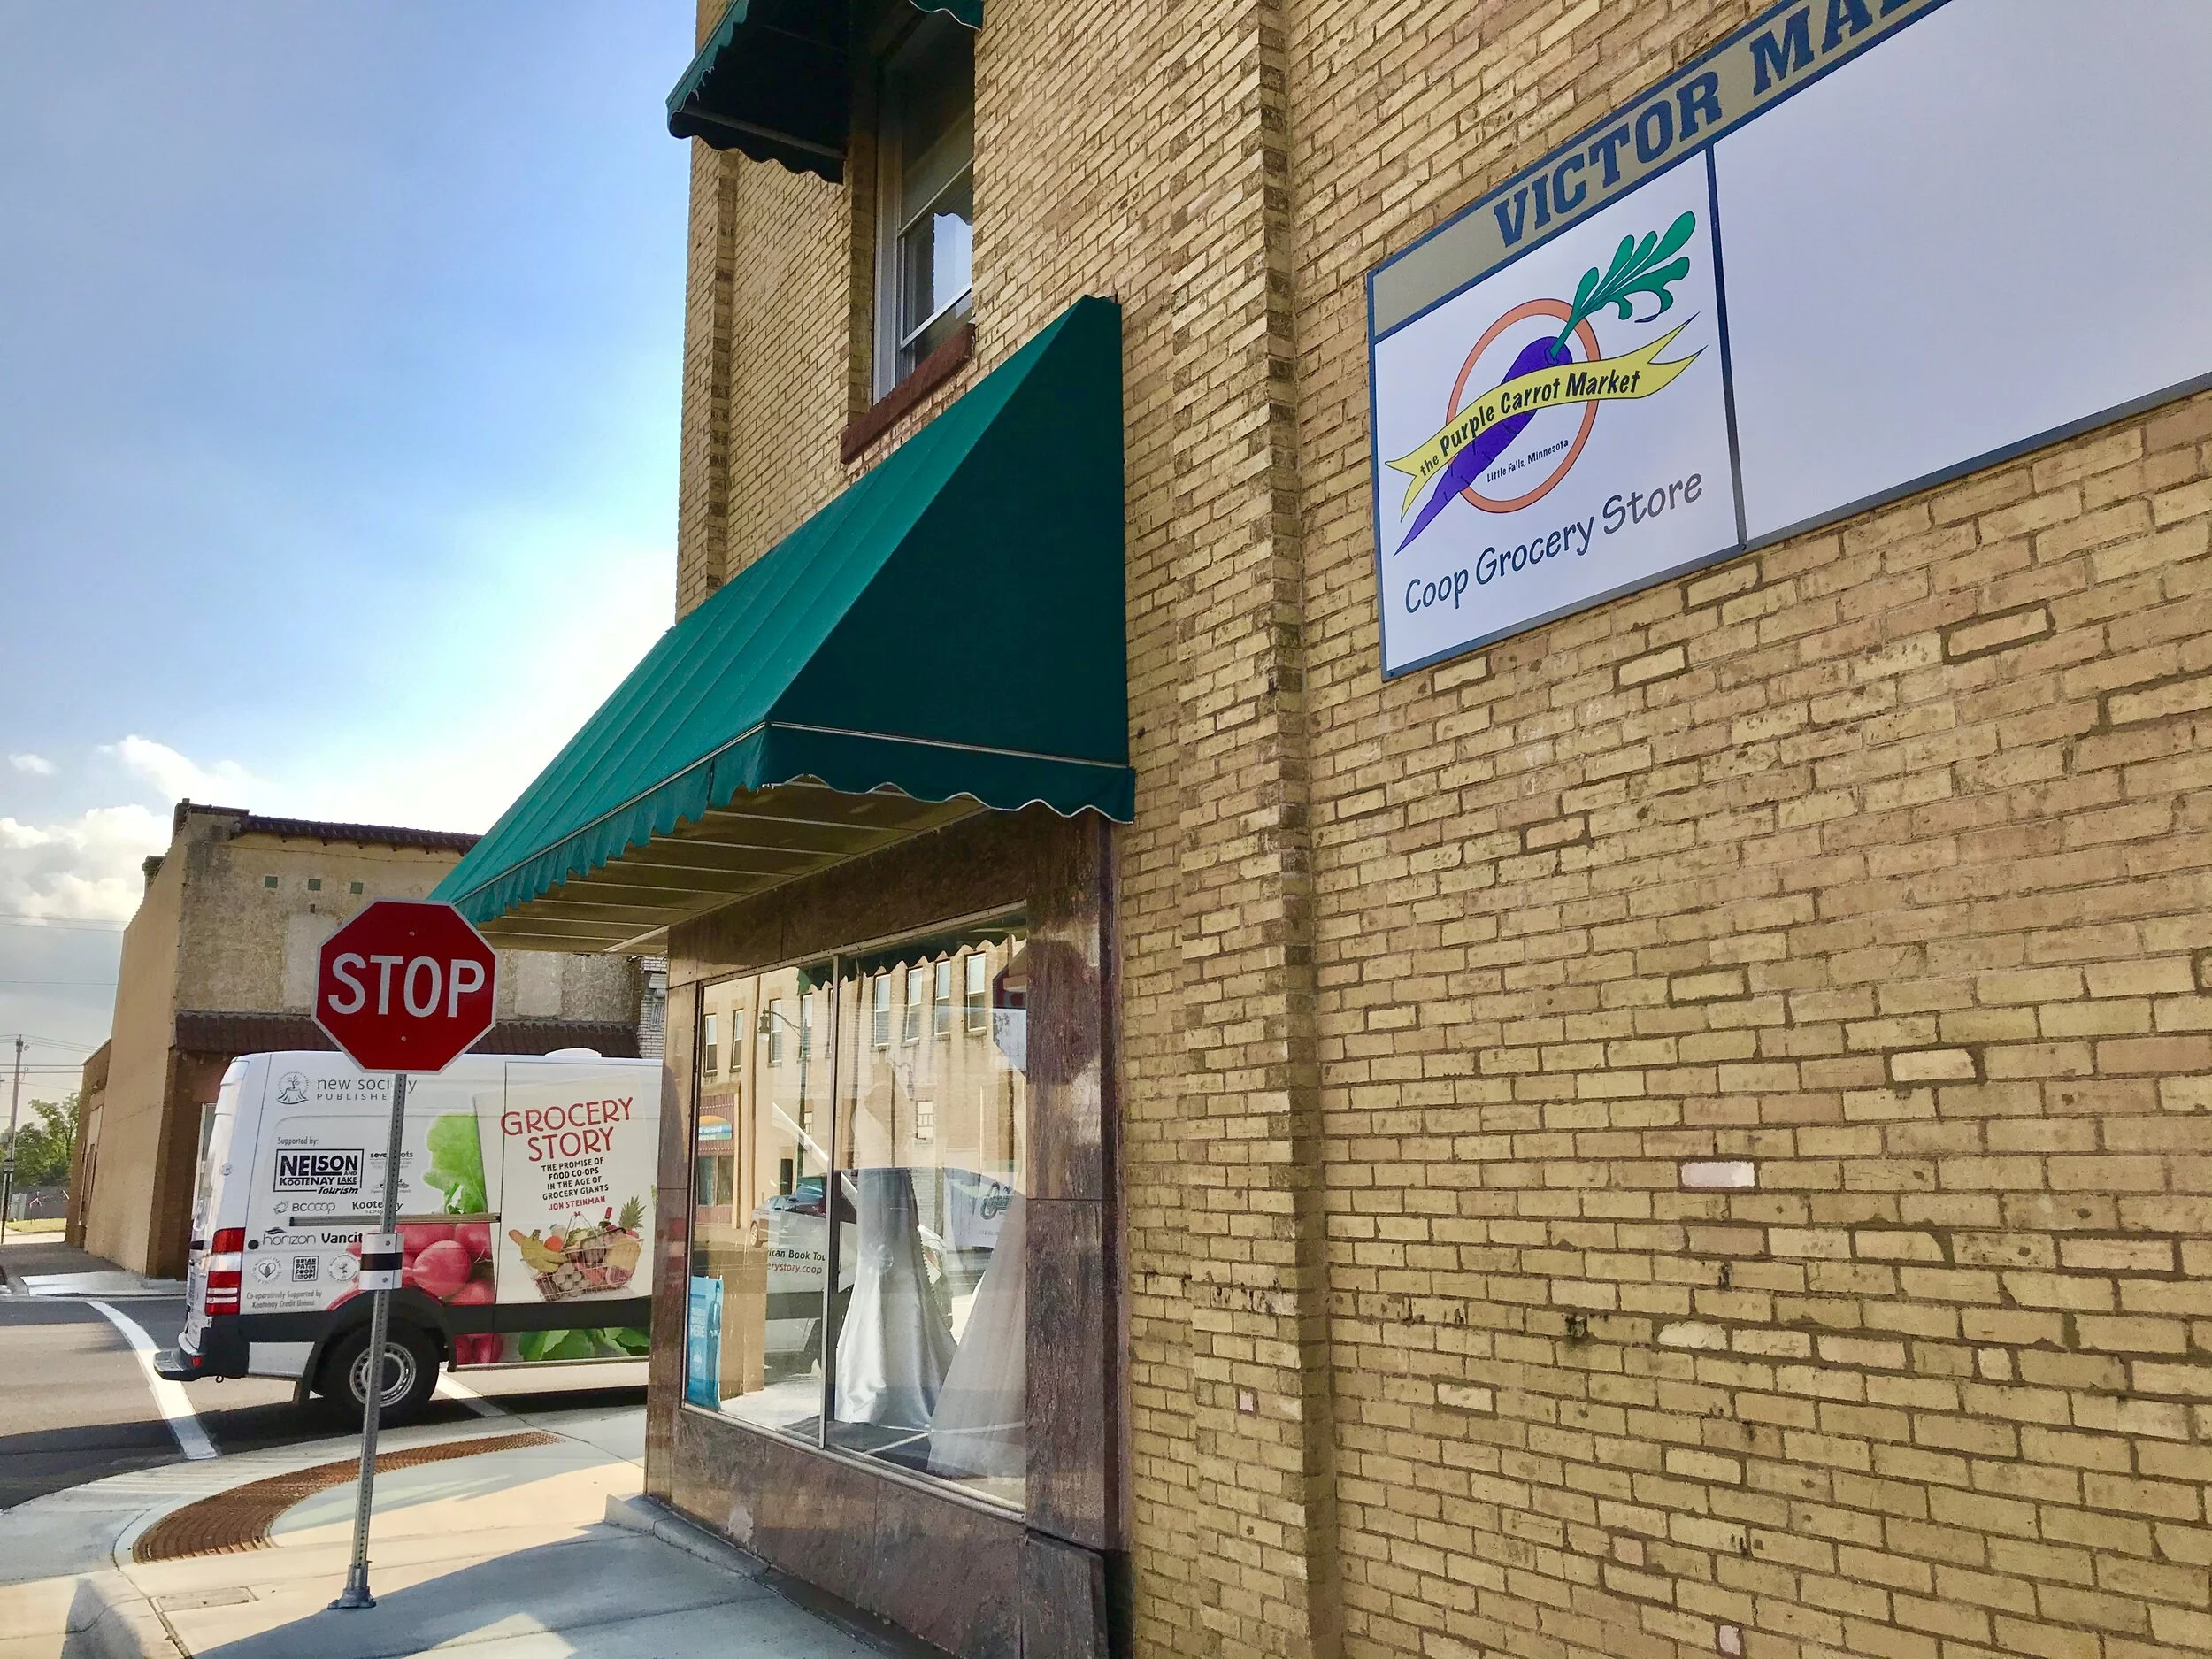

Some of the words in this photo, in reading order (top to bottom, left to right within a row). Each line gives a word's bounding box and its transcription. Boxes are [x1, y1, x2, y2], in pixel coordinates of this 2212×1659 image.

[1494, 70, 1722, 249] VICTOR
[1420, 455, 1439, 477] the
[1440, 408, 1494, 457] Purple
[1501, 378, 1560, 414] Carrot
[1565, 369, 1640, 397] Market
[1486, 469, 1507, 483] Little
[1508, 458, 1526, 473] Falls,
[1527, 439, 1569, 465] Minnesota
[1405, 568, 1469, 614] Coop
[1475, 515, 1595, 586] Grocery
[1602, 472, 1703, 536] Store
[328, 952, 485, 1018] STOP
[317, 1079, 351, 1090] new
[357, 1077, 417, 1094] sociy
[500, 1096, 634, 1136] GROCERY
[277, 1136, 308, 1146] Supported
[527, 1125, 614, 1162] STORY
[280, 1155, 358, 1177] NELSON
[541, 1164, 557, 1172] THE
[558, 1158, 593, 1170] PROMISE
[594, 1156, 604, 1165] OF
[549, 1171, 570, 1180] FOOD
[572, 1166, 599, 1178] CO-OPS
[557, 1179, 572, 1188] THE
[574, 1177, 591, 1187] AGE
[592, 1175, 603, 1184] OF
[317, 1186, 359, 1195] Tourism
[542, 1188, 579, 1201] GROCERY
[580, 1183, 609, 1194] GIANTS
[352, 1199, 403, 1213] Kootey
[548, 1202, 564, 1211] JON
[565, 1195, 606, 1209] STEINMAN
[321, 1231, 363, 1244] Vancit
[768, 1248, 786, 1258] ican
[788, 1249, 810, 1260] Book
